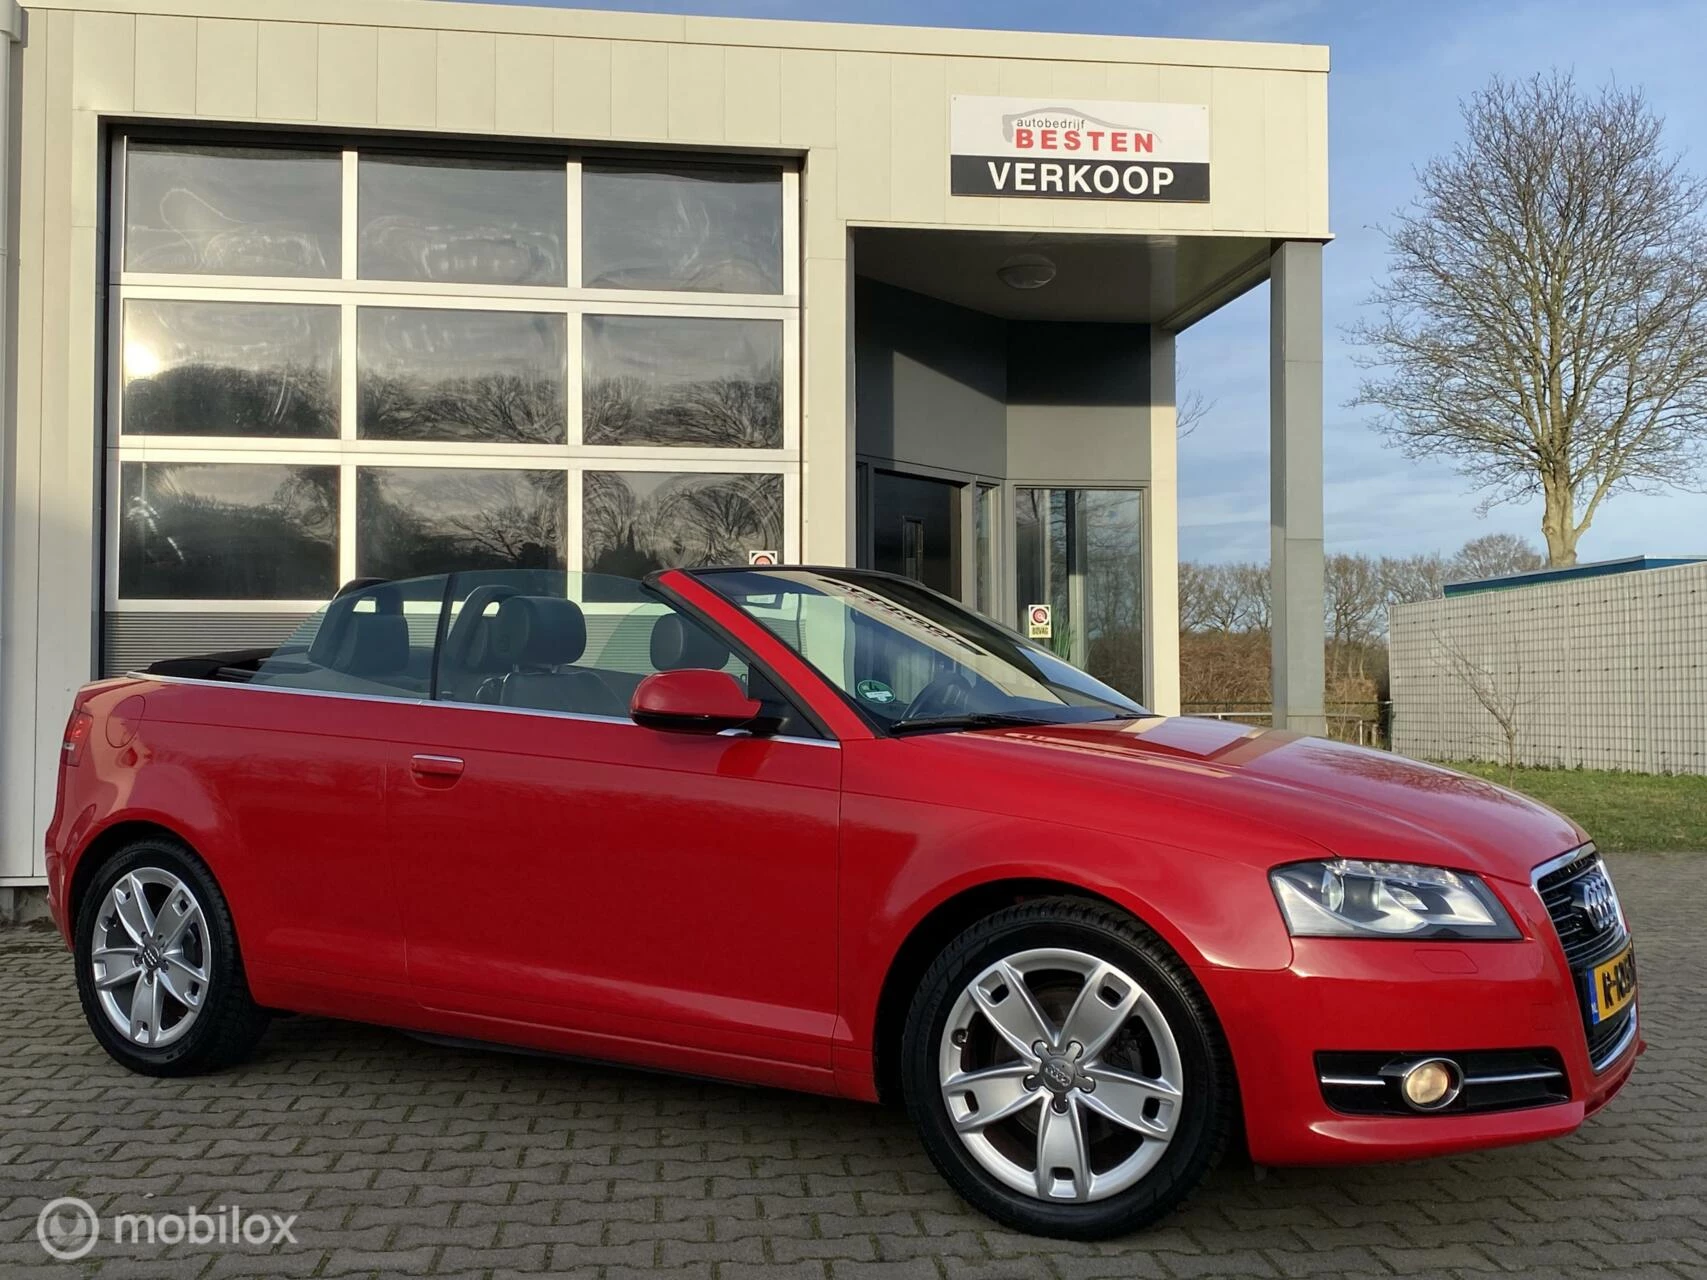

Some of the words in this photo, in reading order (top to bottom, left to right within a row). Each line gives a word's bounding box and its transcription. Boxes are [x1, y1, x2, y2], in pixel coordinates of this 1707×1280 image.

[1016, 117, 1086, 131] autobedrijf
[1015, 128, 1153, 153] BESTEN
[987, 161, 1175, 195] VERKOOP
